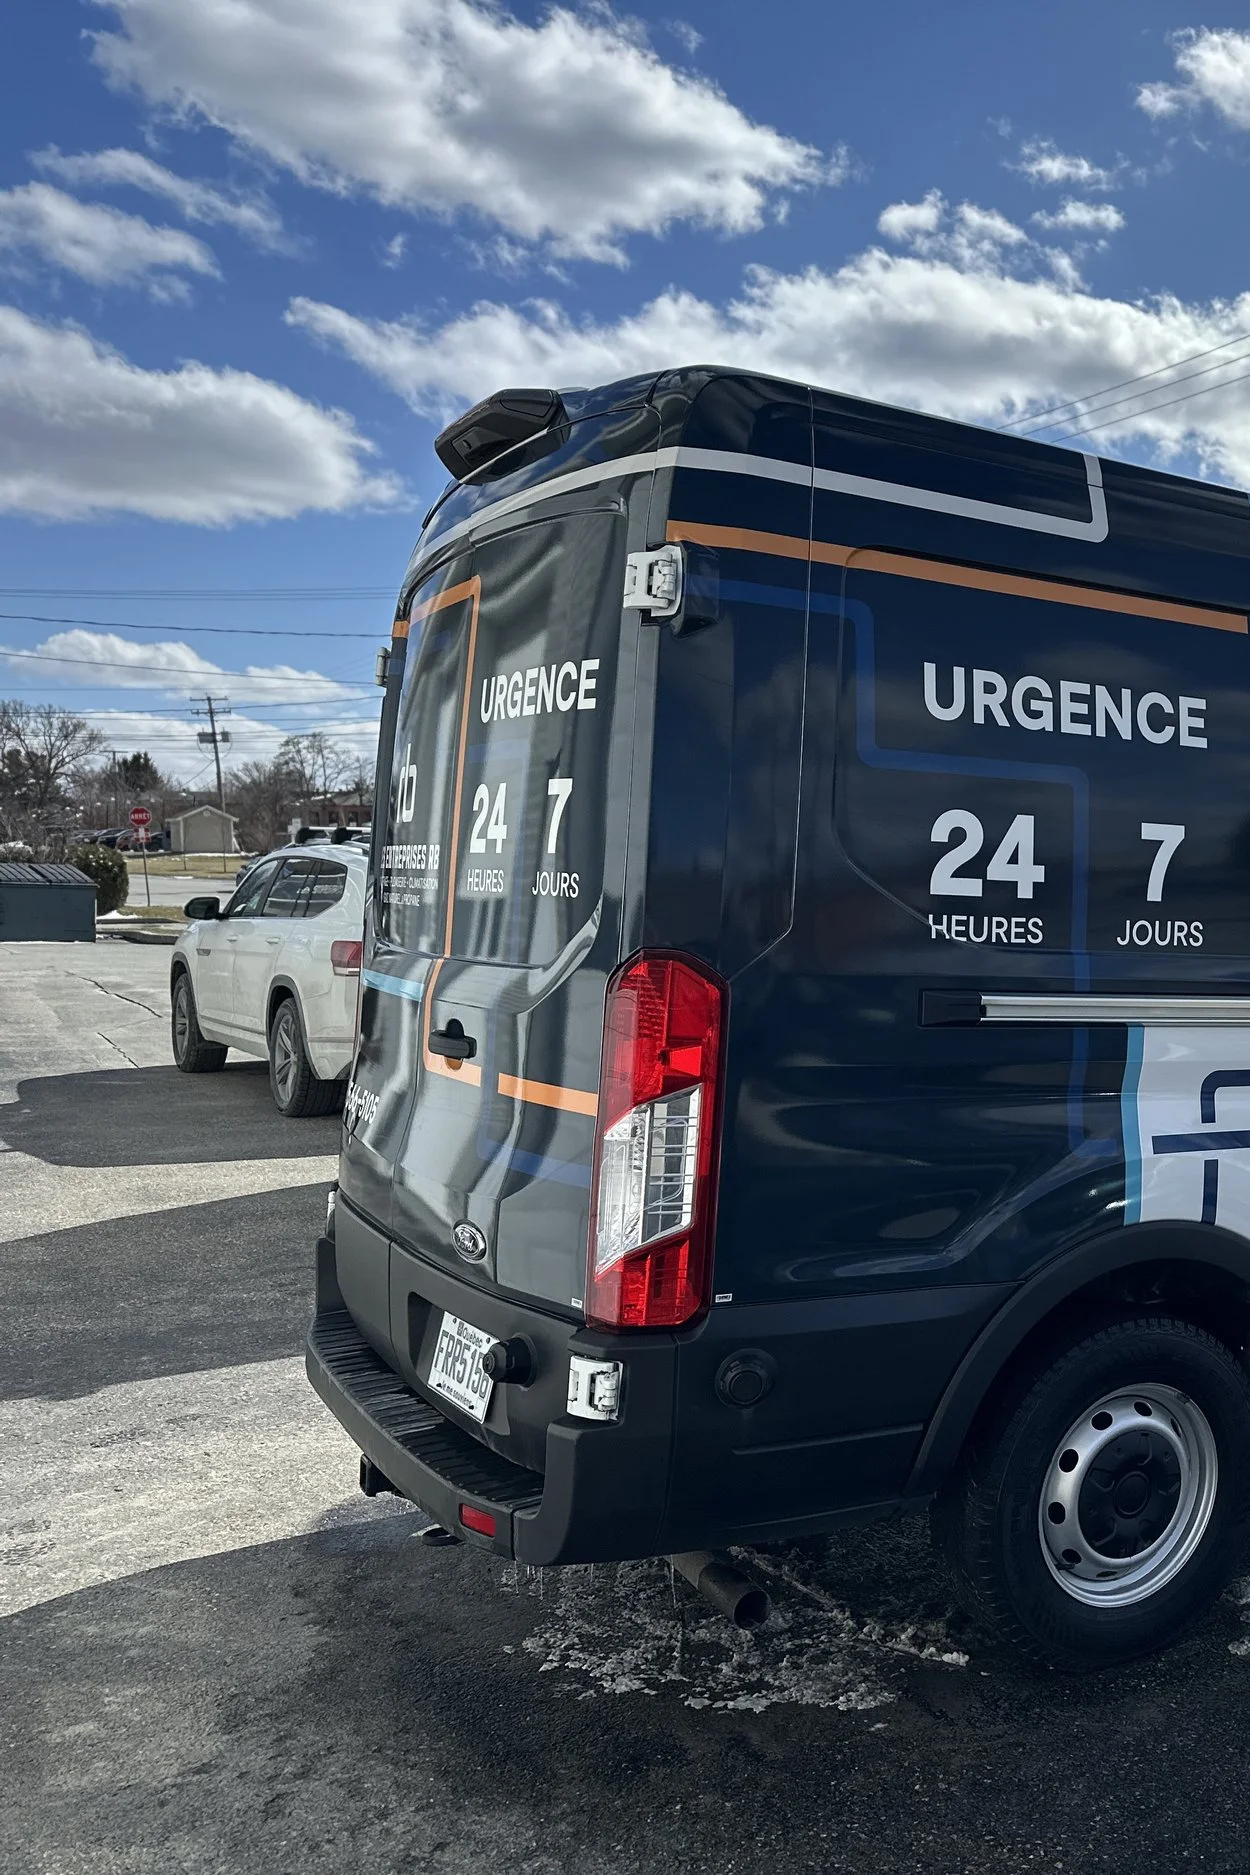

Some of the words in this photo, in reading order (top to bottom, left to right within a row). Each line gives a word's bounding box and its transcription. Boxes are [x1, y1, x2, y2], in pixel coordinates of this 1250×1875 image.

[480, 657, 601, 724] URGENCE
[923, 661, 1208, 749] URGENCE
[469, 782, 508, 854] 24
[547, 777, 574, 854] 7
[427, 844, 440, 870] RB
[467, 868, 505, 893] HEURES
[532, 872, 580, 899] JOURS
[929, 809, 1045, 899] 24
[1141, 822, 1186, 902] 7
[928, 914, 1044, 944] HEURES
[1116, 919, 1204, 947] JOURS
